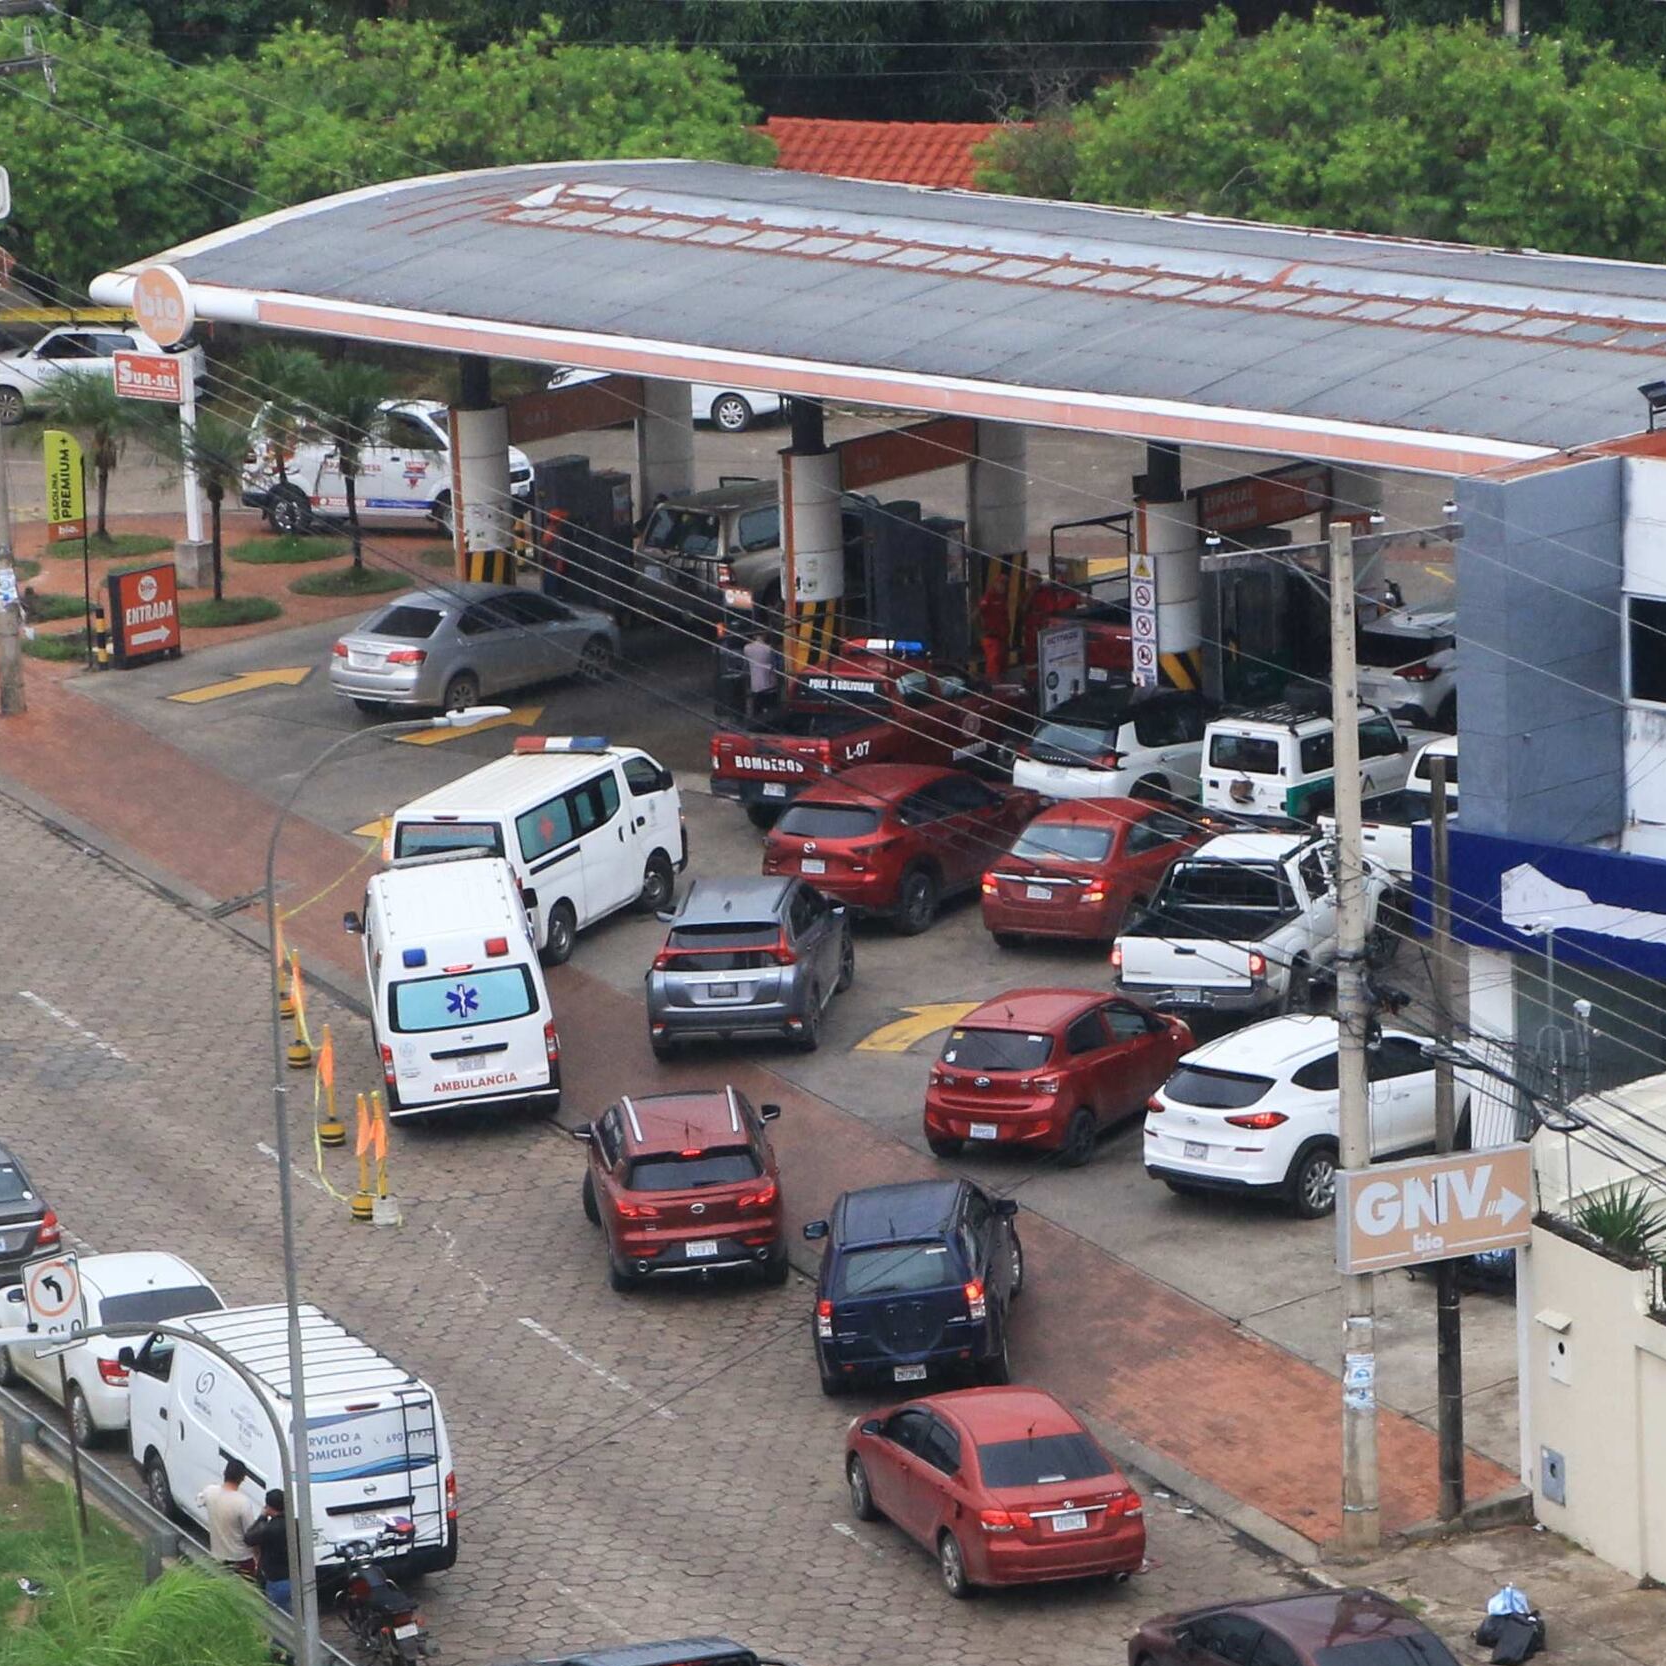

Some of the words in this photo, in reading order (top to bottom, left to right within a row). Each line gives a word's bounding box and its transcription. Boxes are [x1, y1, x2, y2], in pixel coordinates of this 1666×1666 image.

[59, 449, 72, 519] PREMIUM
[125, 599, 174, 626] ENTRADA
[845, 741, 871, 760] L-07
[735, 755, 804, 773] BOMBEROS
[433, 1072, 517, 1093] AMBULANCIA
[1354, 1164, 1493, 1236] GNV
[1412, 1231, 1445, 1254] bio
[308, 1432, 349, 1447] RVICIO
[353, 1432, 361, 1441] A
[307, 1445, 362, 1462] OMICILIO
